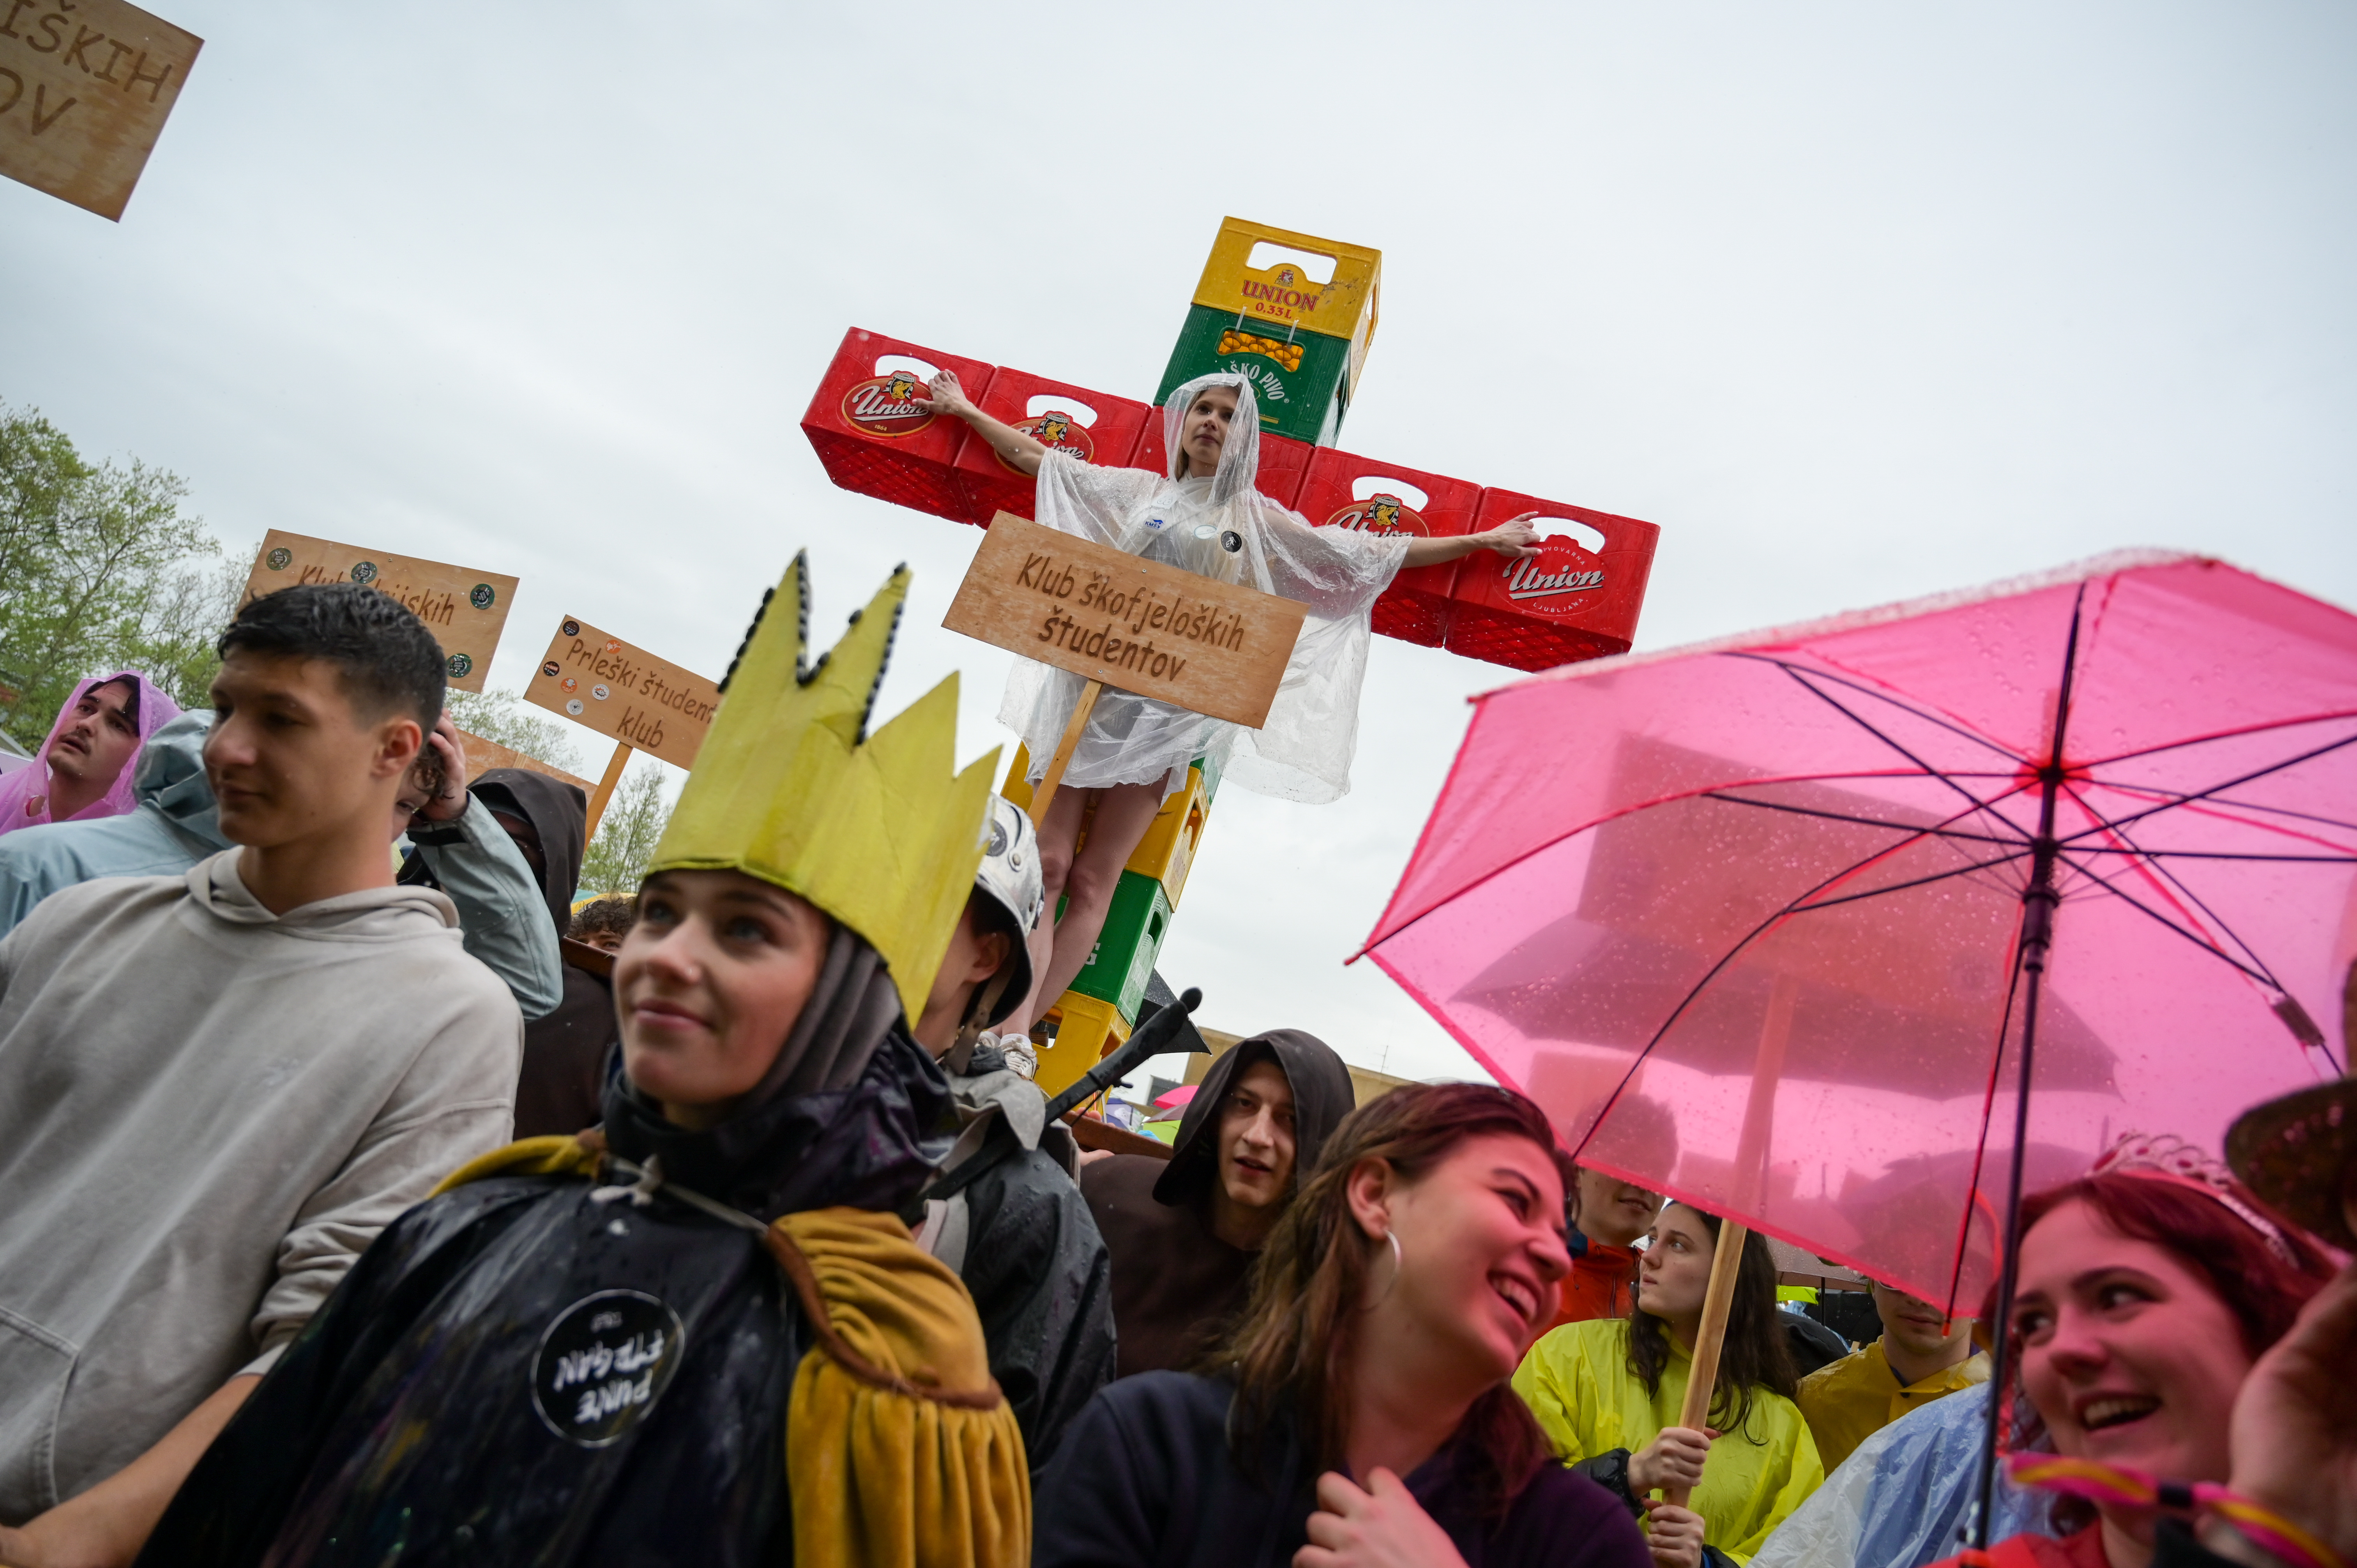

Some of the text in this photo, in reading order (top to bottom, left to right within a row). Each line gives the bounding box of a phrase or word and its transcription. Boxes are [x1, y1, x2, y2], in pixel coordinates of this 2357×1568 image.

[1242, 279, 1320, 312] UNION
[1221, 360, 1285, 400] ŠKO PIVO
[852, 385, 929, 415] Union
[1502, 556, 1605, 591] Union
[1543, 546, 1585, 565] IVOVARNA
[1016, 553, 1246, 652] Klub škofjeloških
[1533, 598, 1583, 613] LJUBLJANA
[1038, 605, 1187, 682] študentov
[566, 639, 641, 689] Prleški
[616, 706, 664, 749] klub
